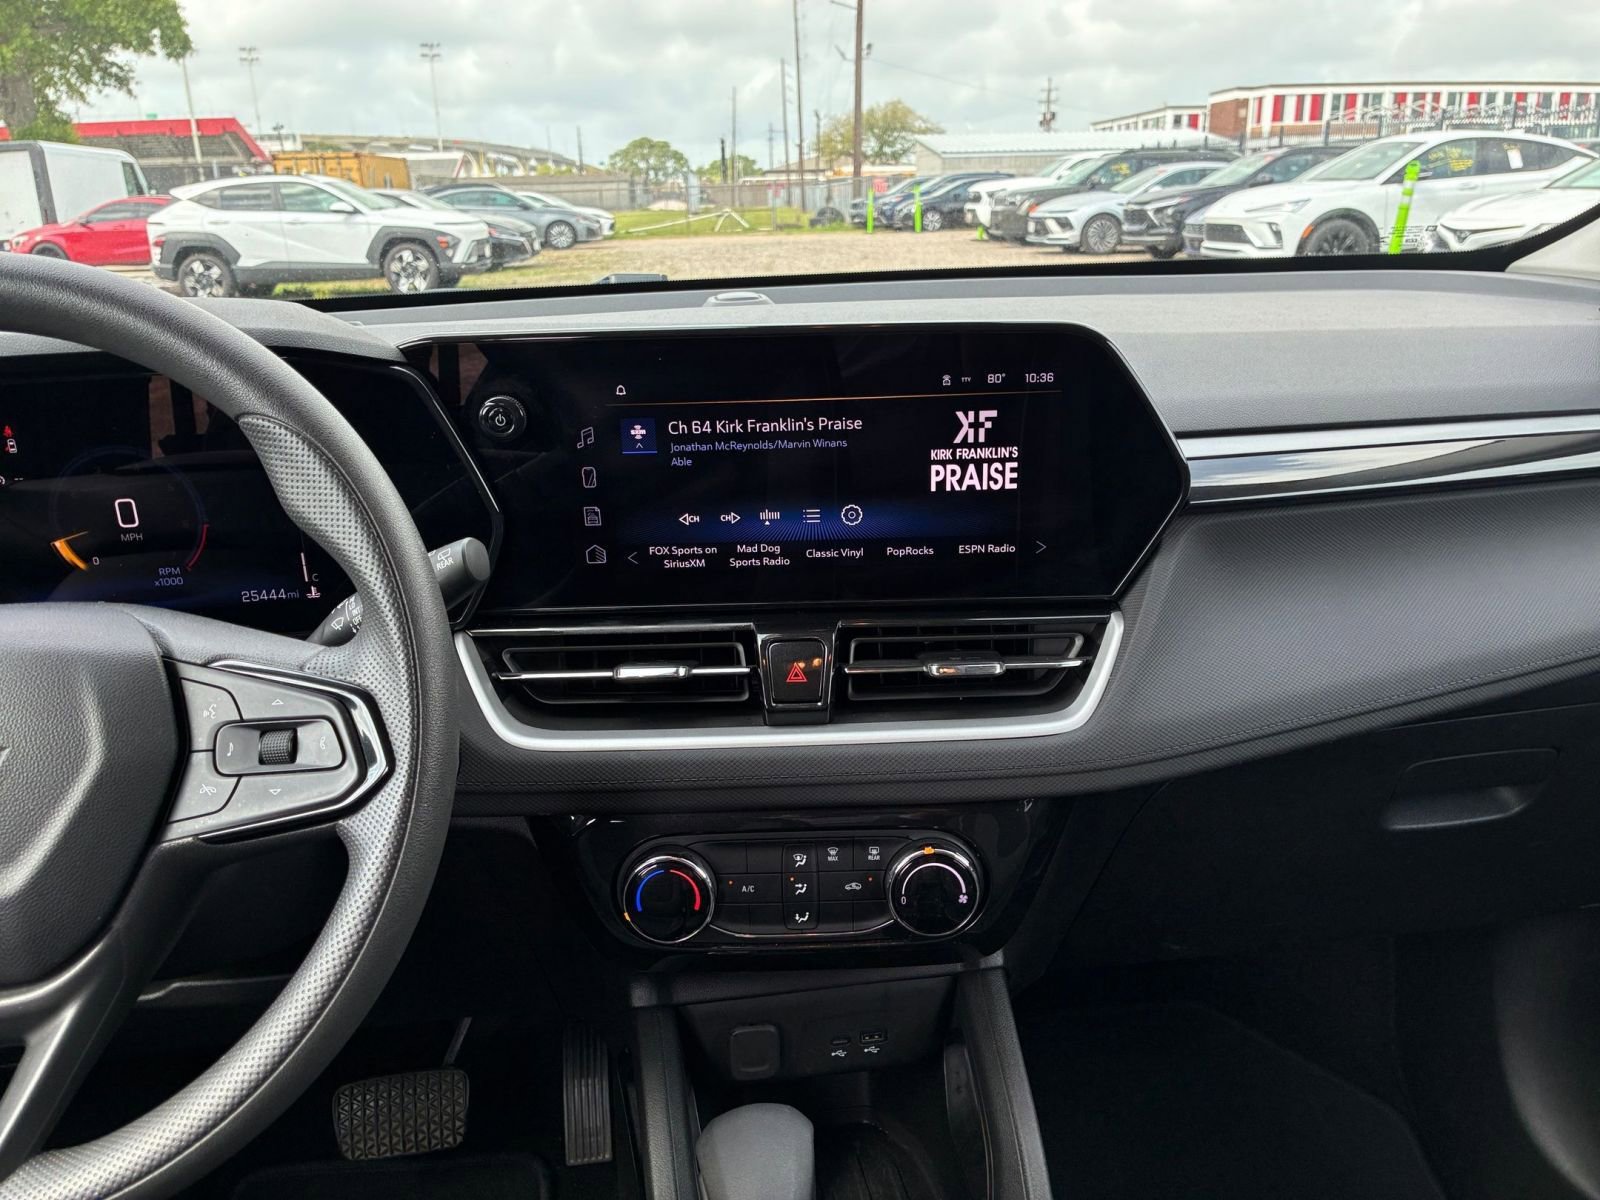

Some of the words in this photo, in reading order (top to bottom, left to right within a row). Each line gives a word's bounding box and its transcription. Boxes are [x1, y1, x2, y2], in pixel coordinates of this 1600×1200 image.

[1025, 373, 1054, 383] 10:36
[668, 421, 688, 435] Ch
[691, 420, 712, 434] 64
[716, 419, 744, 434] Kirk
[747, 417, 815, 433] Franklin's
[818, 417, 863, 431] Praise
[670, 442, 713, 454] Jonathan
[715, 440, 811, 453] McReynolds/Marvin
[812, 439, 848, 448] Winans
[930, 449, 953, 461] KIRK
[956, 446, 1018, 460] FRANKLIN'S
[671, 457, 693, 467] Able
[930, 461, 1018, 492] PRAISE
[115, 499, 140, 528] 0
[689, 515, 700, 523] CH
[720, 514, 731, 522] CH
[120, 533, 144, 543] MPH
[649, 546, 670, 556] FOX
[671, 546, 703, 557] Sports
[705, 546, 718, 555] on
[737, 544, 758, 554] Mad
[760, 543, 781, 555] Dog
[805, 548, 839, 558] Classic
[840, 547, 864, 559] Vinyl
[886, 546, 934, 557] PopRocks
[958, 544, 985, 554] ESPN
[987, 543, 1016, 554] Radio
[436, 557, 454, 570] REAR
[663, 559, 706, 569] SiriusXM
[729, 557, 761, 568] Sports
[762, 556, 791, 567] Radio
[158, 567, 181, 576] RPM
[154, 577, 184, 587] x1000
[311, 573, 319, 582] C
[827, 855, 839, 863] MAX
[741, 884, 756, 894] A/C
